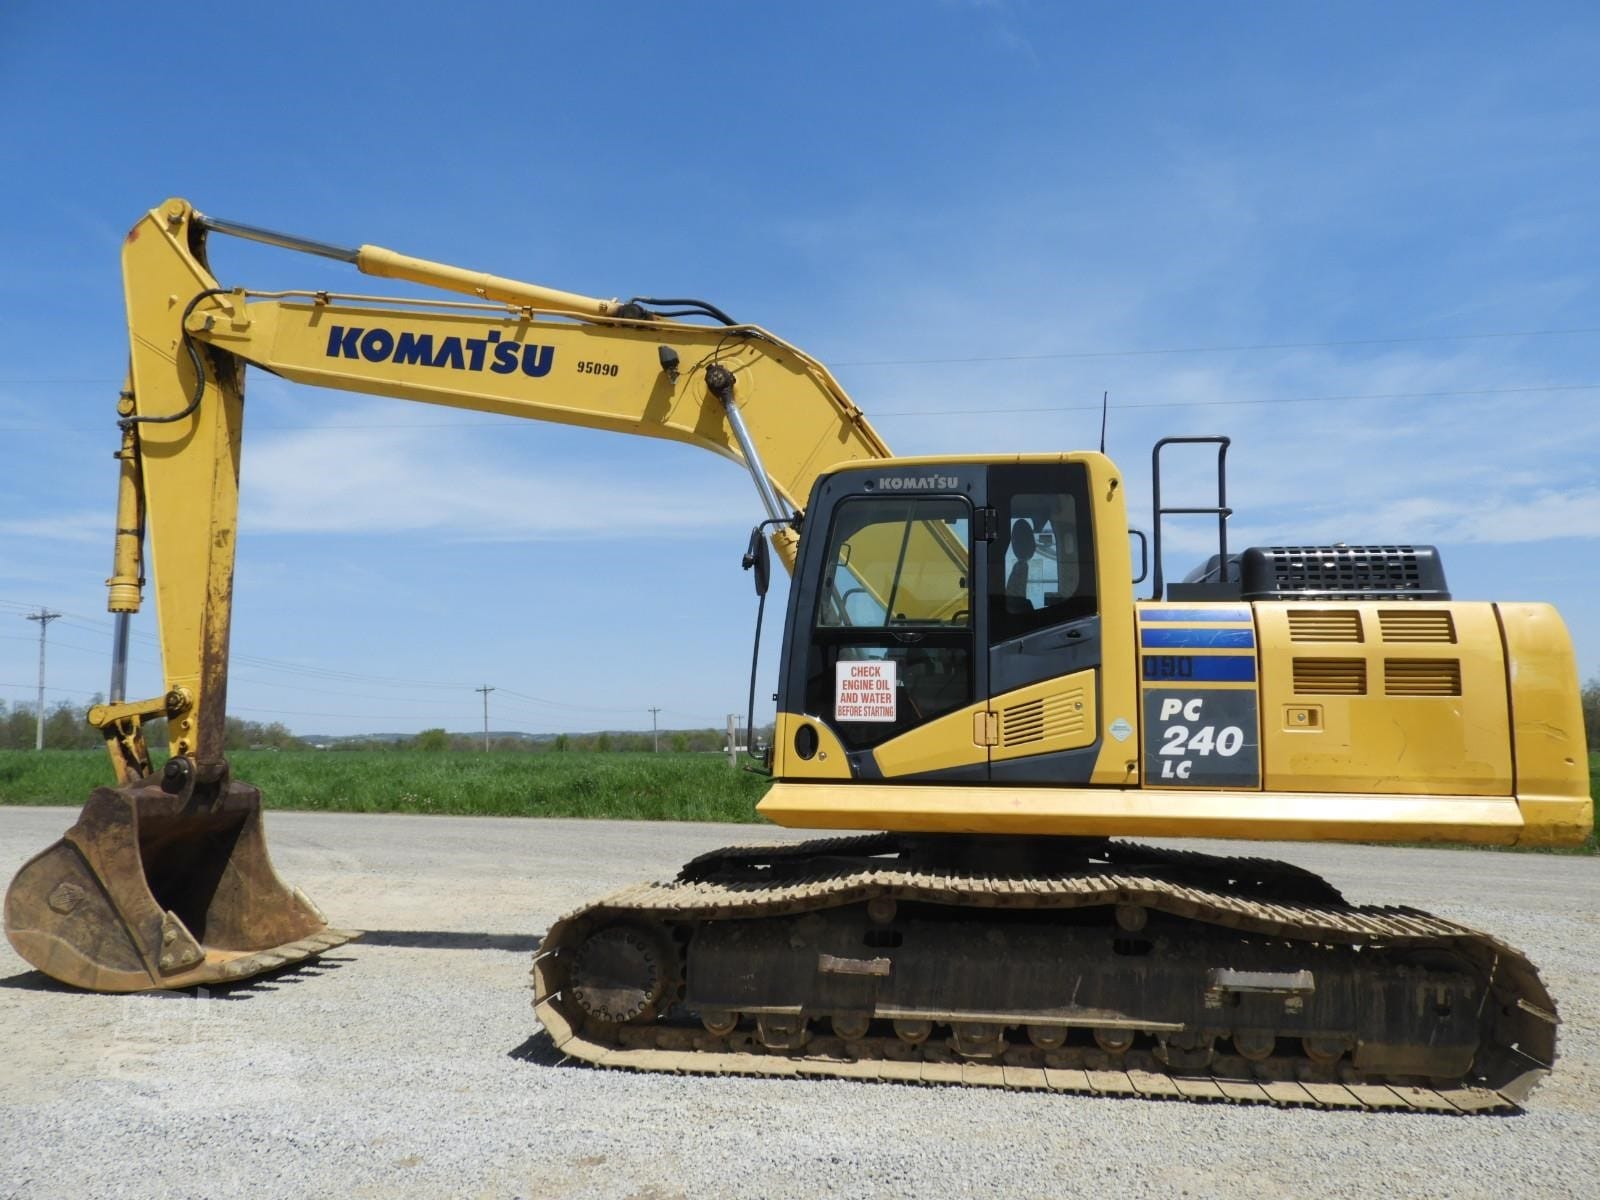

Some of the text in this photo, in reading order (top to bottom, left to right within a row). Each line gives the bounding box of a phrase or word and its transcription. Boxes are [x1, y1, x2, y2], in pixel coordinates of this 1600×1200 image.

[326, 325, 555, 378] KOMATSU
[577, 360, 619, 377] 95090
[879, 473, 959, 490] KOMATSU
[850, 666, 881, 678] CHECK
[842, 679, 890, 691] ENGINE OIL
[840, 692, 892, 704] AND WATER
[837, 705, 894, 717] BEFORE STARTING
[1159, 698, 1203, 722] PC
[1158, 725, 1244, 757] 240
[1160, 759, 1193, 779] LC
